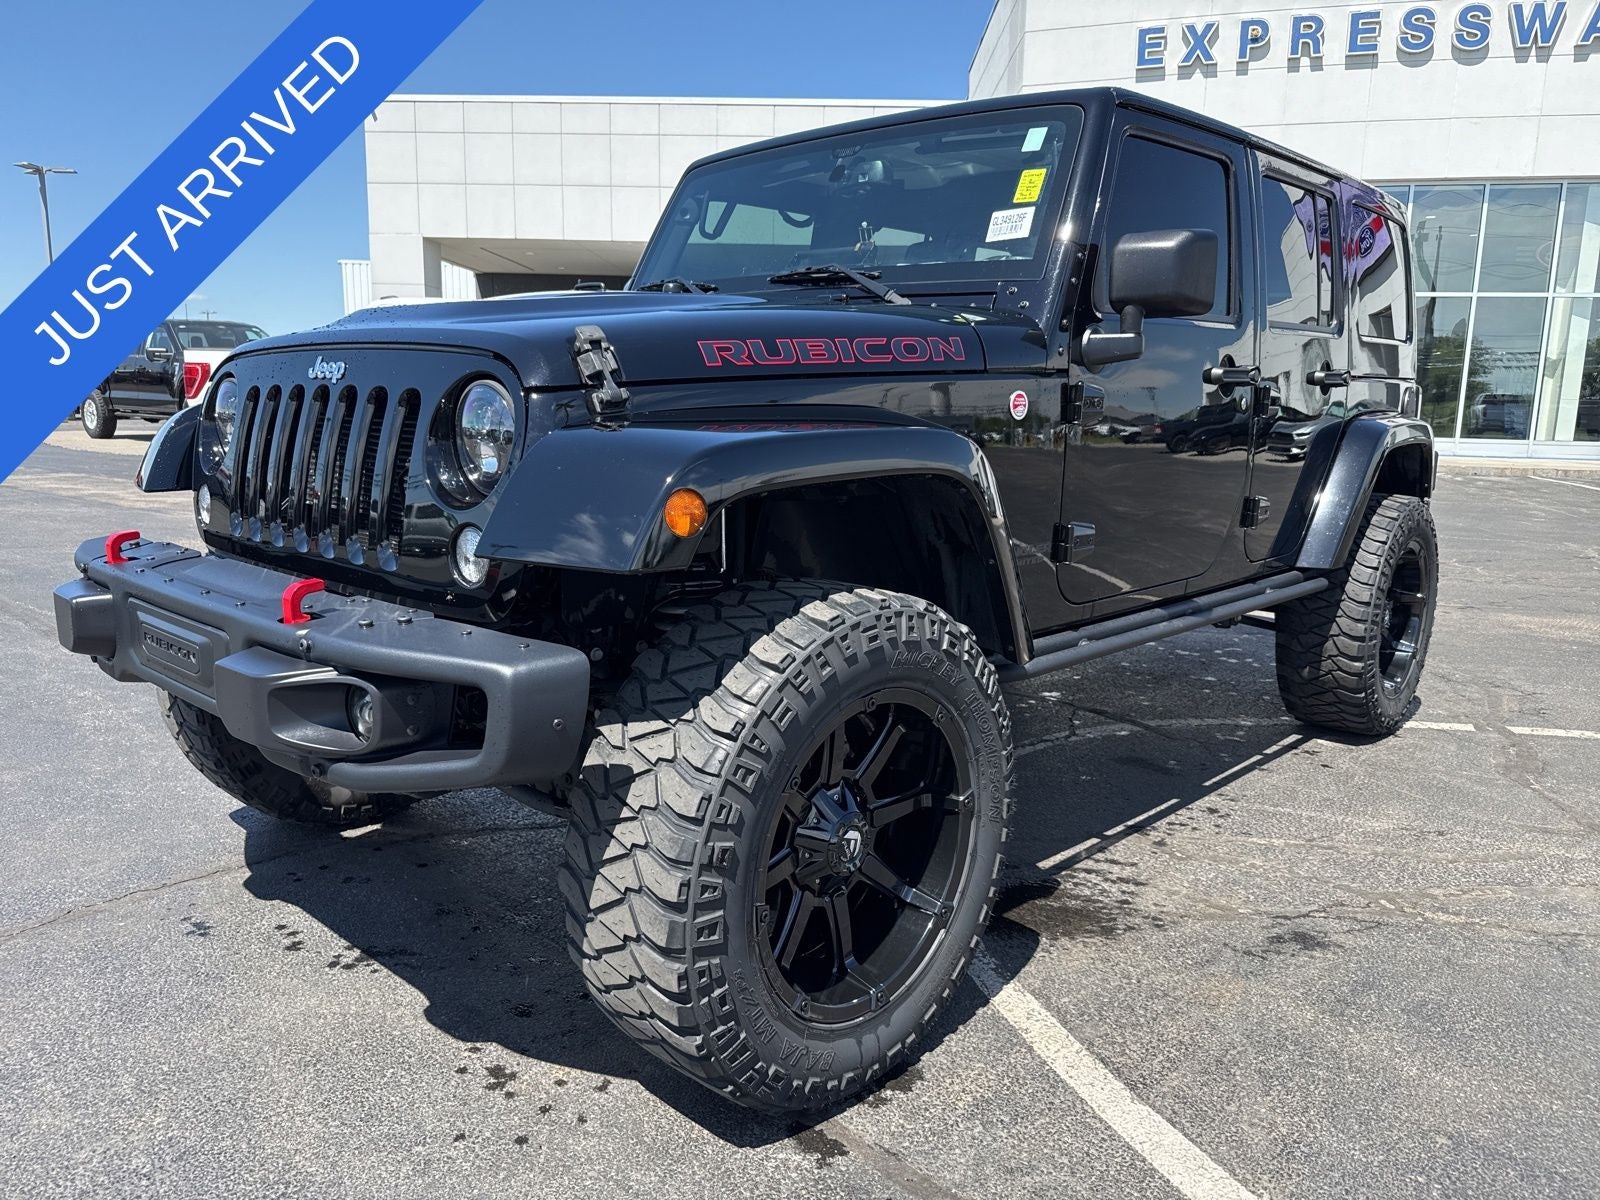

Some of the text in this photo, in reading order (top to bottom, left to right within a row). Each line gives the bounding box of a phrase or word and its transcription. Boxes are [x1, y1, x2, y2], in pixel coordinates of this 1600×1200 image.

[697, 336, 966, 367] RUBICON
[308, 355, 346, 384] Jeep
[143, 632, 197, 664] RUBICON
[891, 650, 967, 688] MICKEY
[965, 689, 1000, 823] THOMPSON
[779, 1037, 836, 1071] BAJA
